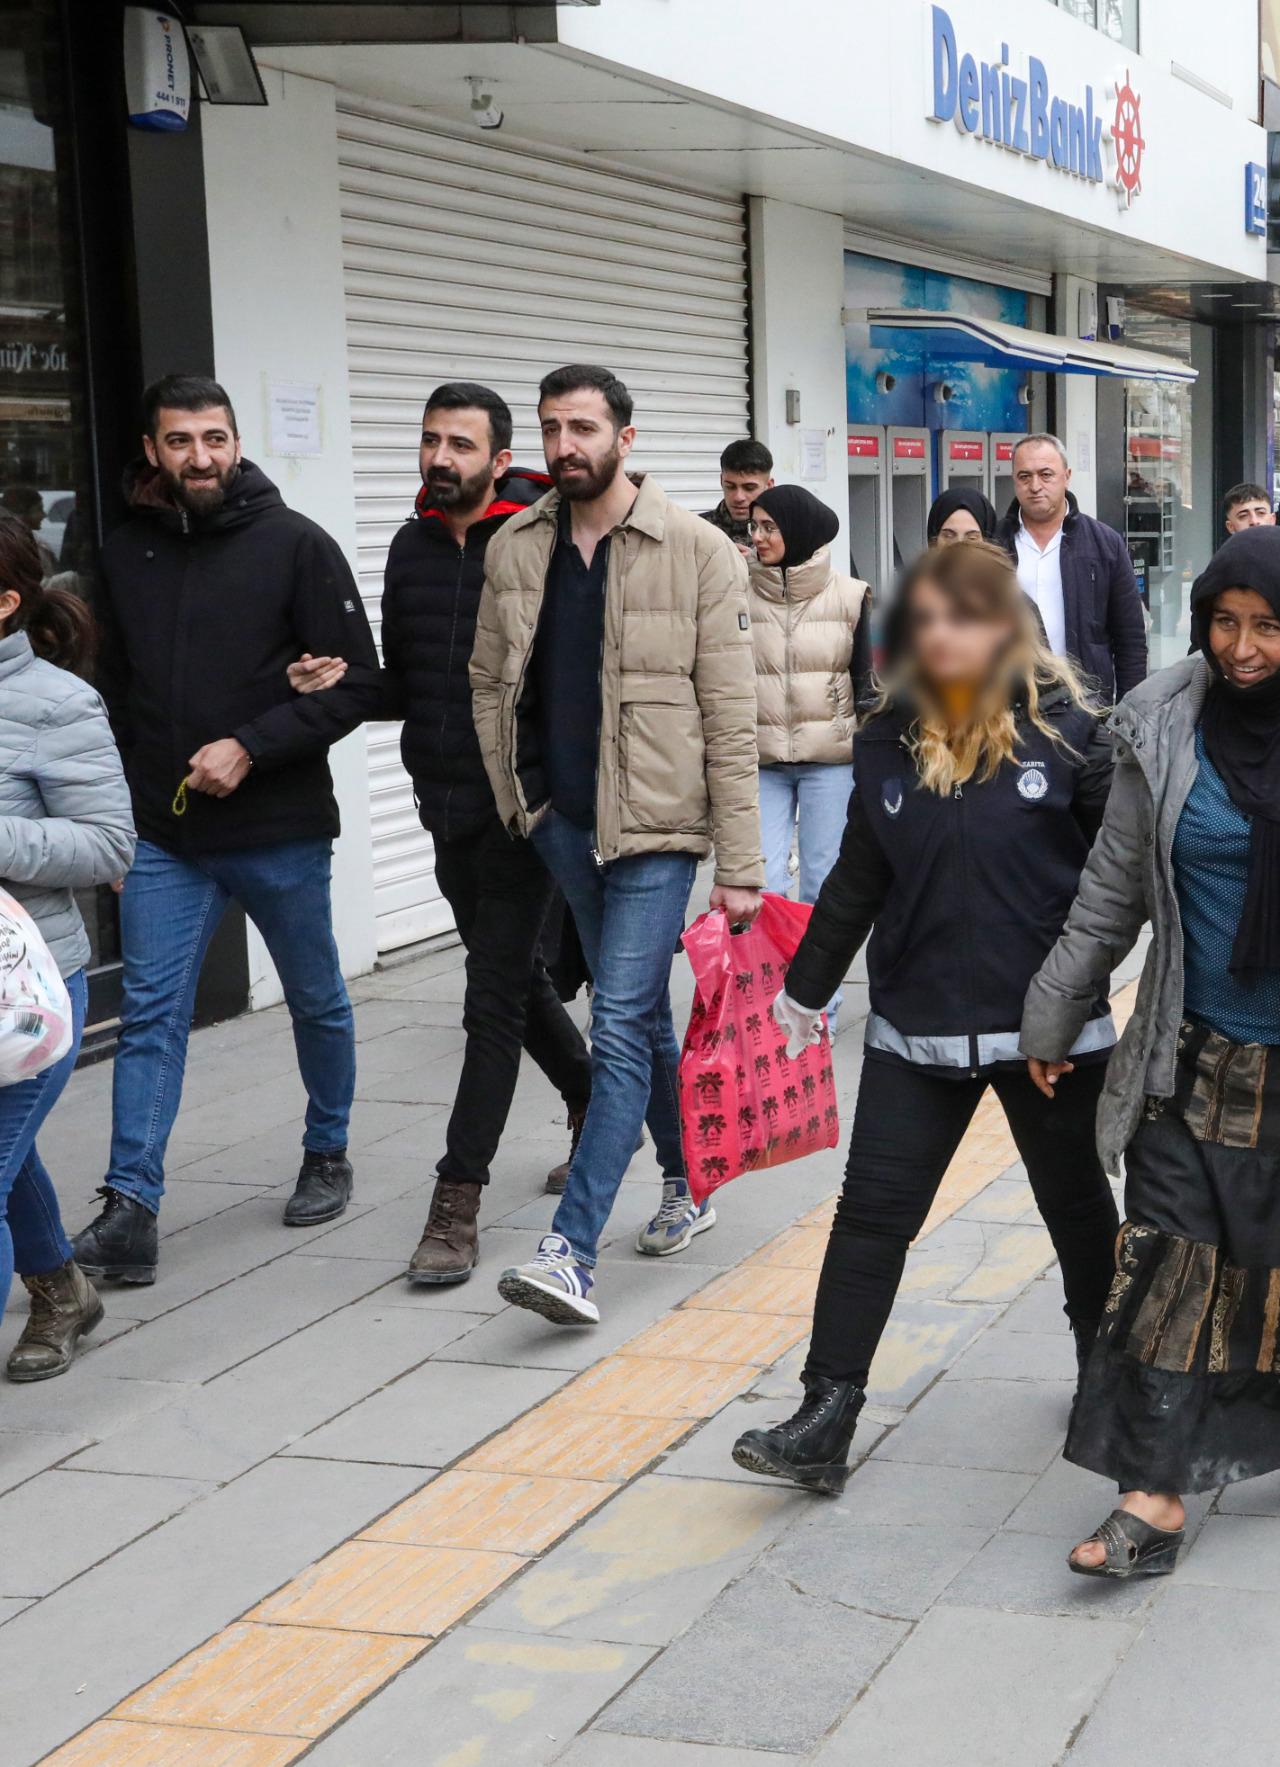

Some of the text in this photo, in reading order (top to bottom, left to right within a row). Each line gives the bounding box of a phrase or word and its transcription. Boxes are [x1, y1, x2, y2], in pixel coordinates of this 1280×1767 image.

[164, 35, 175, 91] PRONET
[156, 91, 169, 103] 444
[931, 3, 1103, 184] DenizBank
